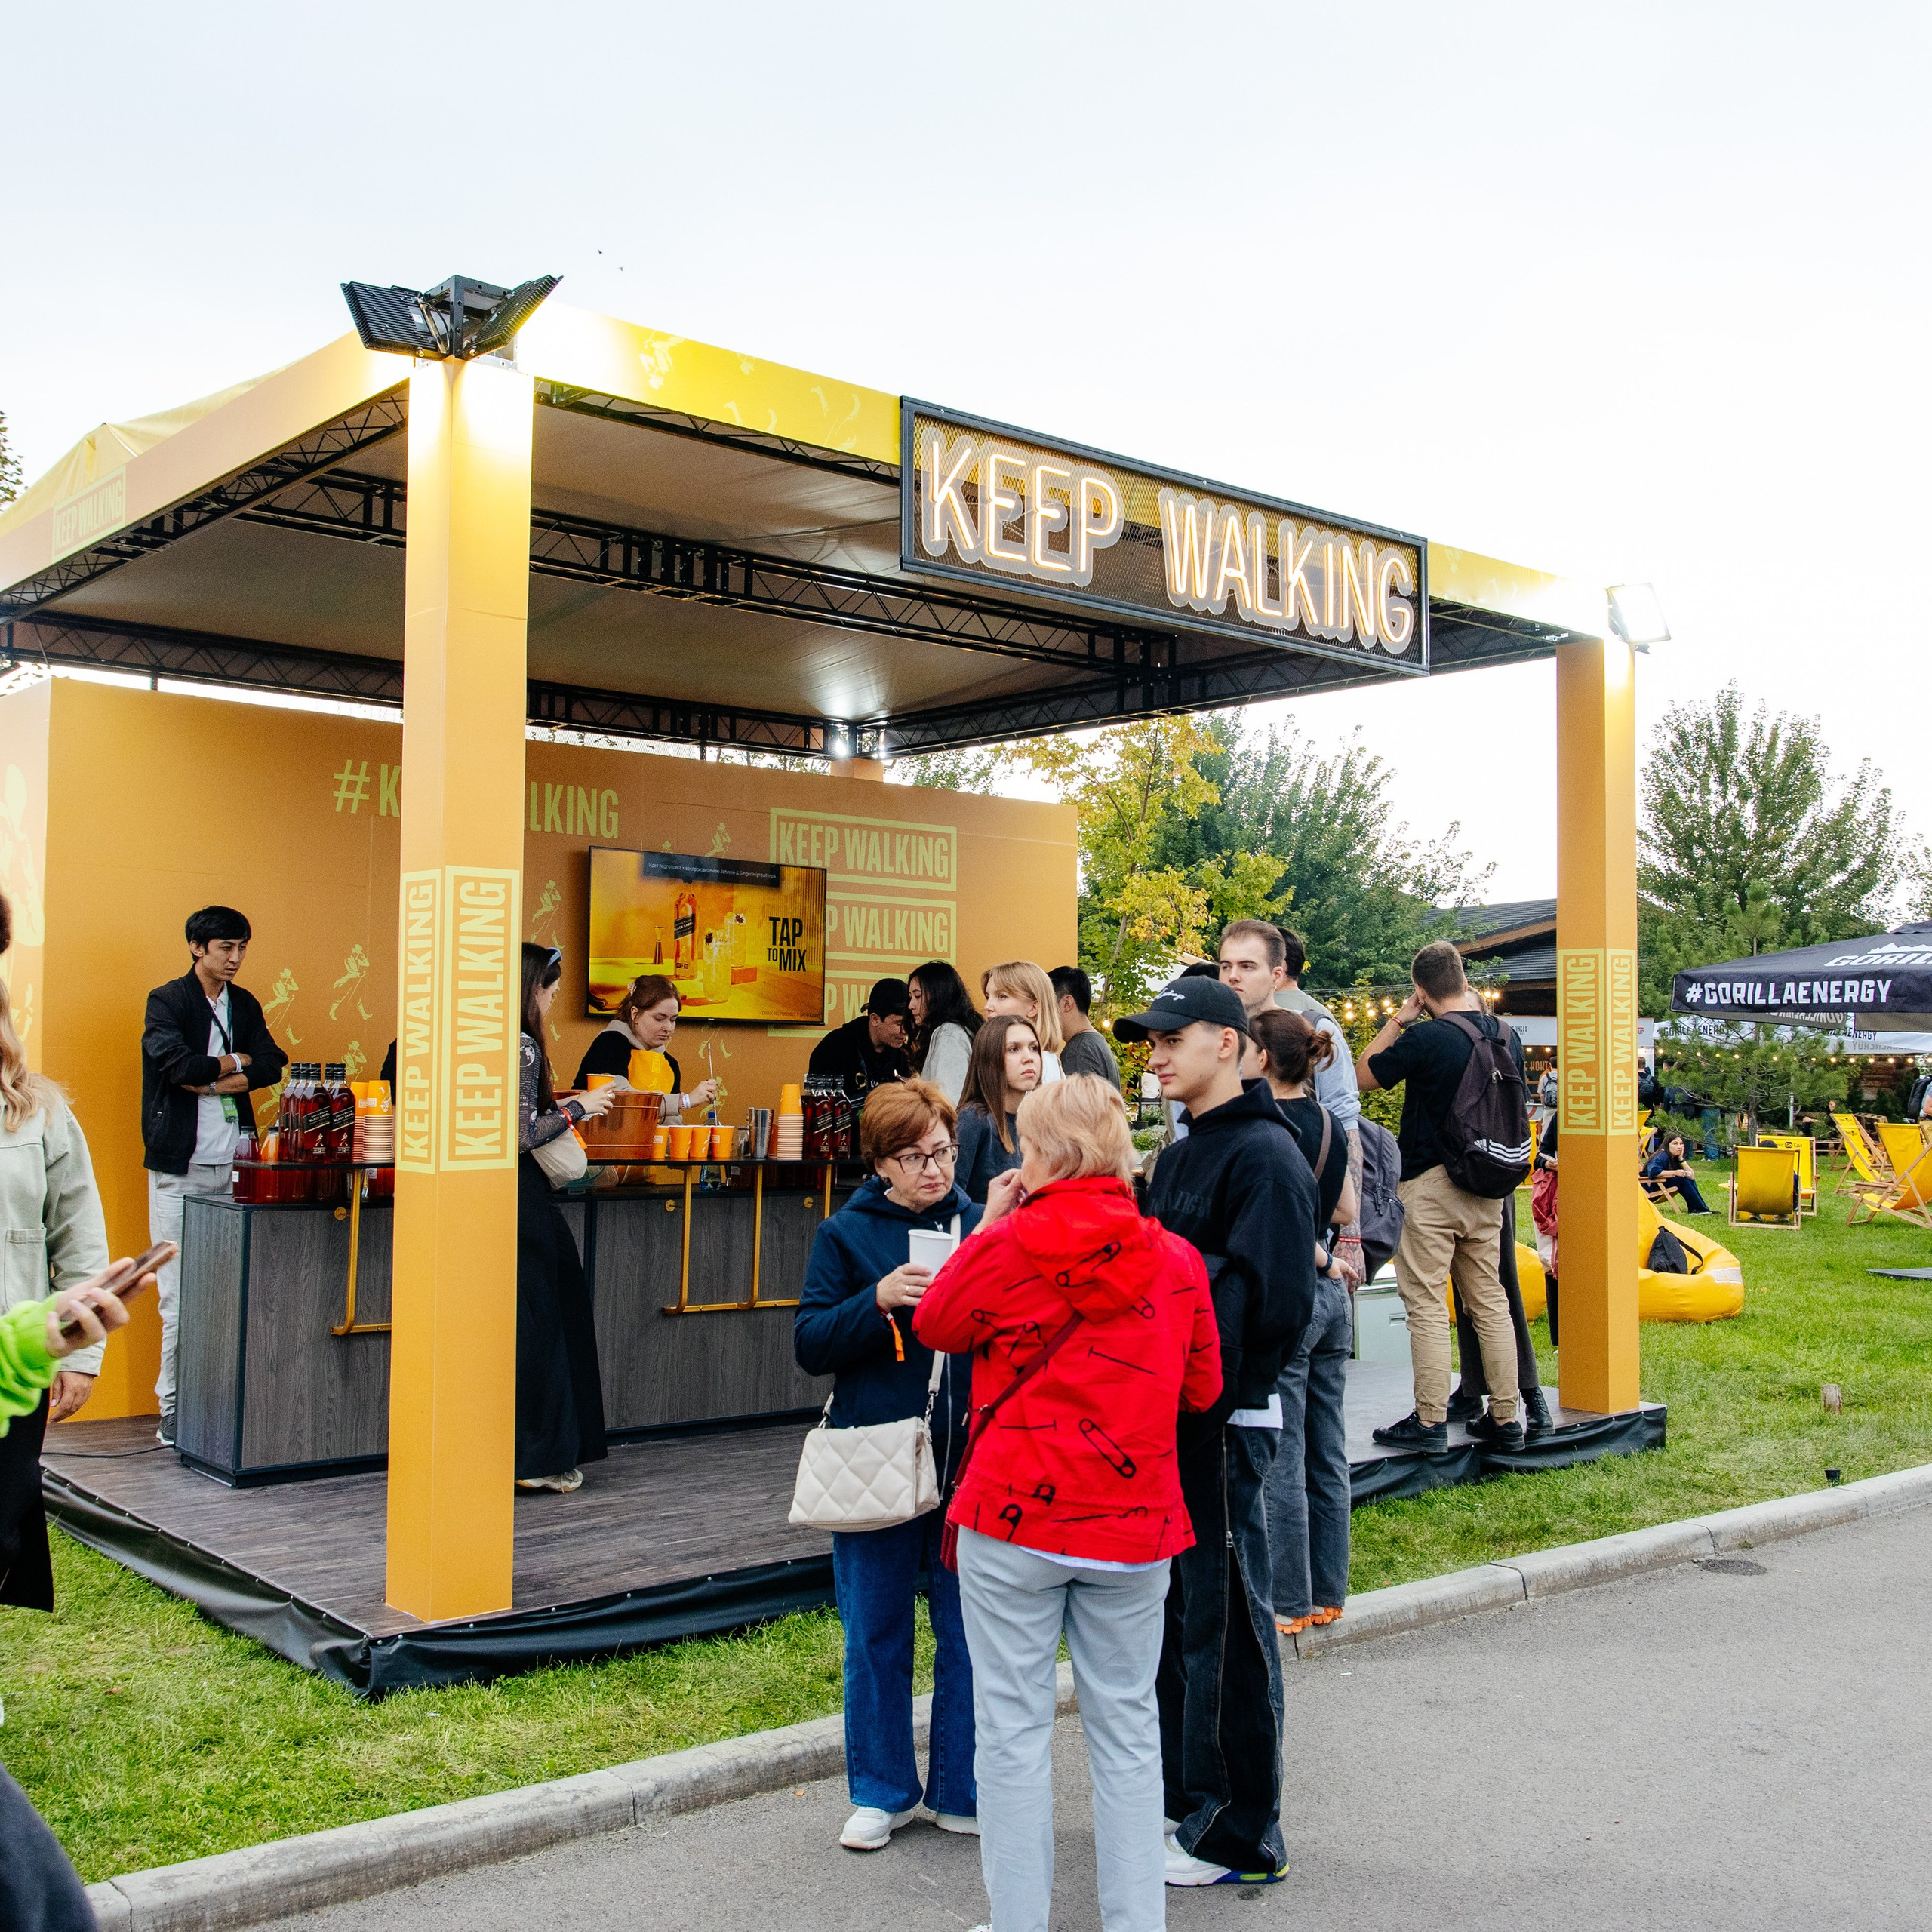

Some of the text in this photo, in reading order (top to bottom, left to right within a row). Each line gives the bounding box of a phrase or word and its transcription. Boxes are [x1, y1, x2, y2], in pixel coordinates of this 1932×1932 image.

[55, 479, 122, 552] KEEP WALKING
[924, 430, 1413, 651] KEEP WALKING
[780, 820, 949, 878] KEEP WALKING
[767, 948, 807, 972] TO MIX
[768, 916, 803, 947] TAP
[843, 906, 949, 953] WALKING
[405, 884, 433, 1158] KEEP WALKING
[455, 881, 506, 1155] KEEP WALKING
[1685, 980, 1892, 1004] #GORILLAENERGY
[1567, 957, 1597, 1126] KEEP WALKING
[1613, 958, 1632, 1126] KEEP WALKING
